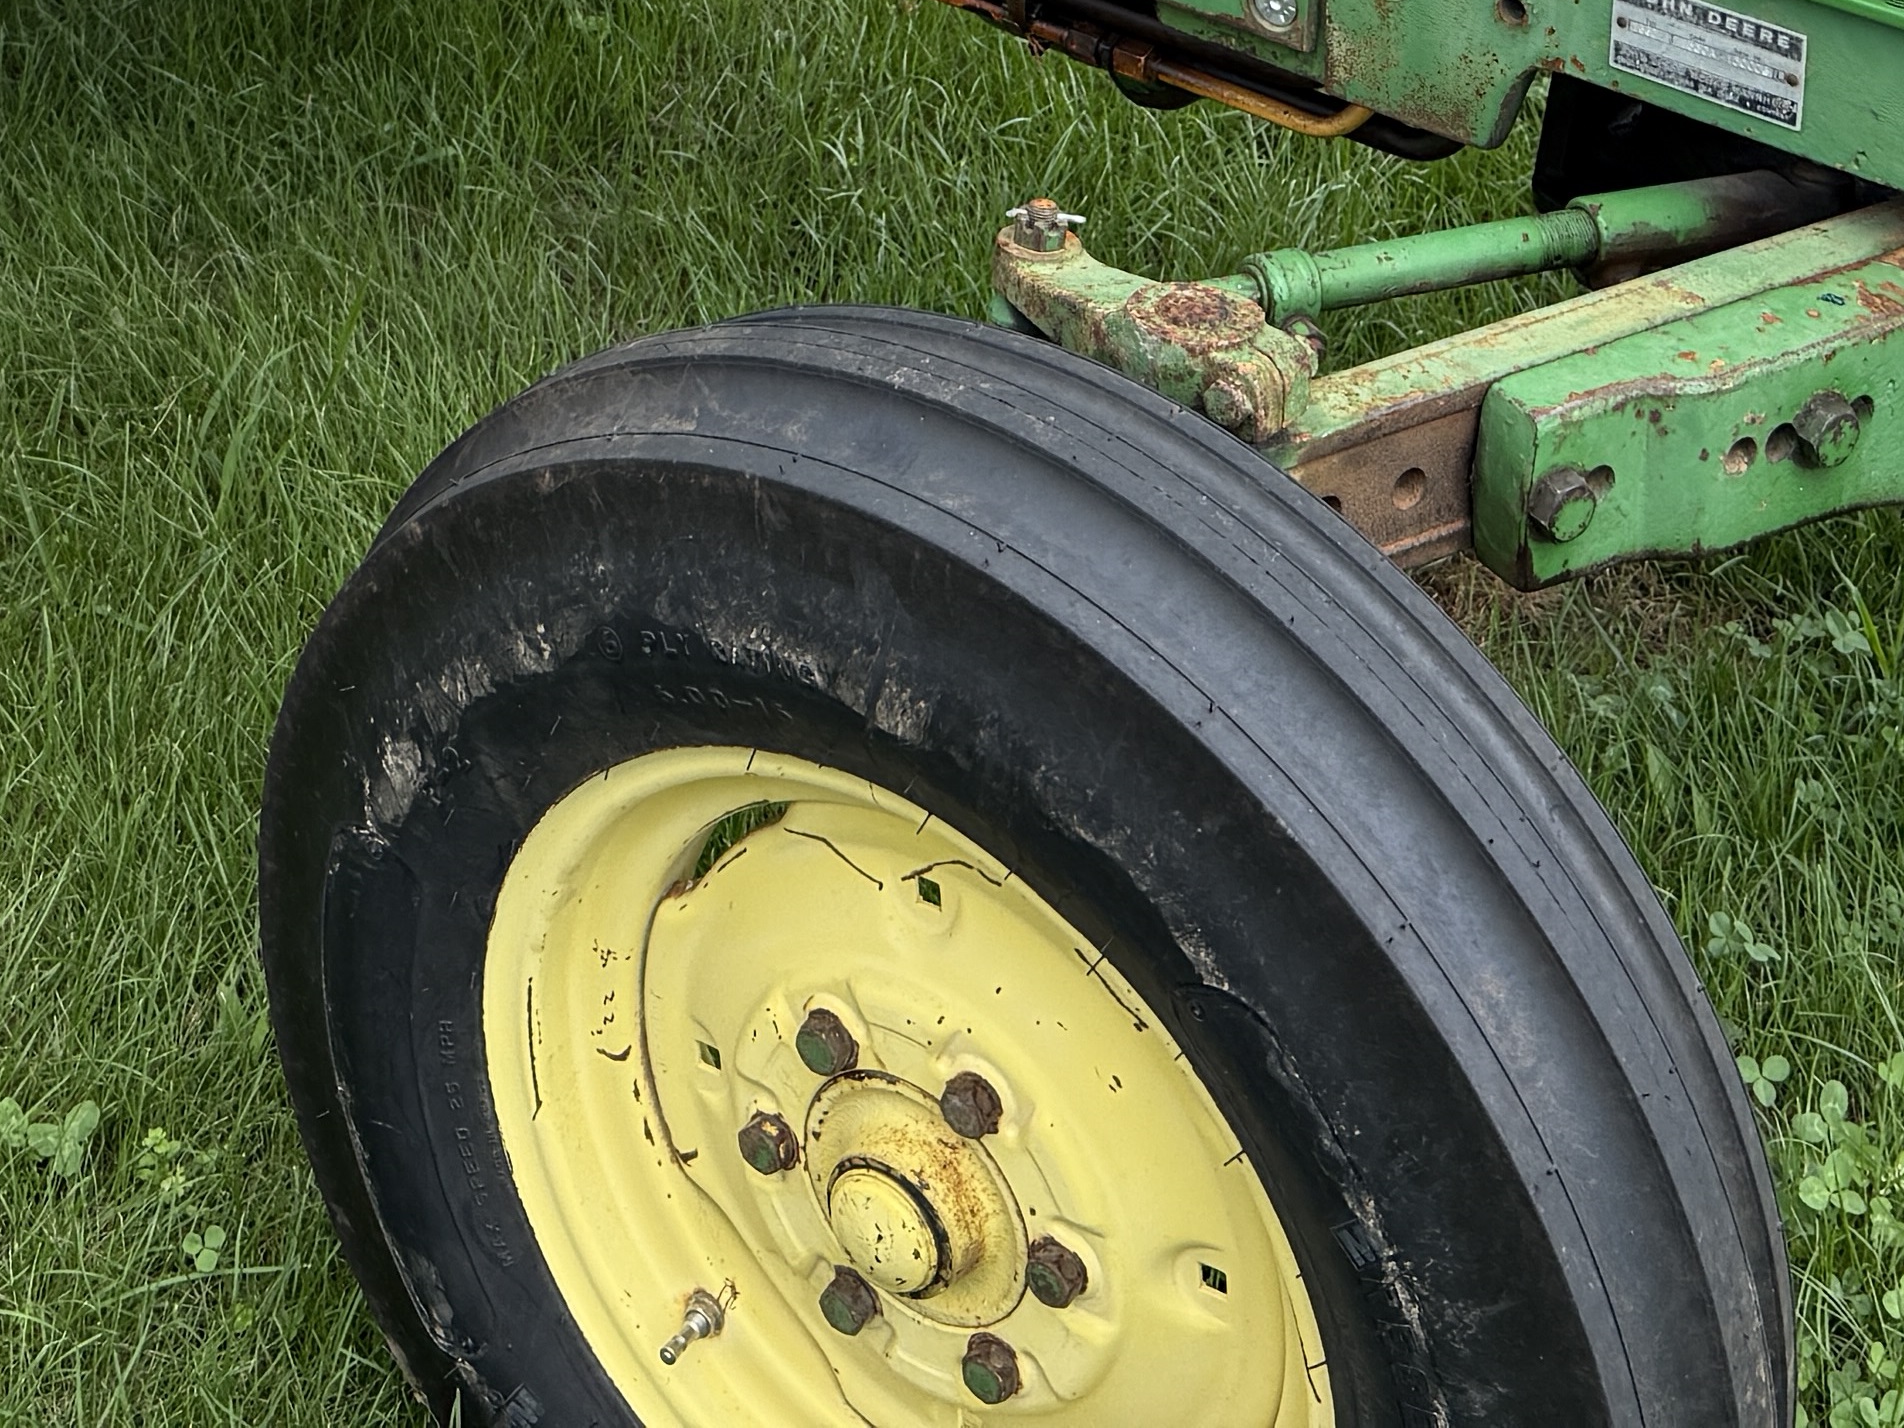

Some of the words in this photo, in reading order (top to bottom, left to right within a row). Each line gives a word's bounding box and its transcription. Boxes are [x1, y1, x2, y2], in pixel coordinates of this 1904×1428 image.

[1707, 10, 1791, 50] DEERE
[438, 1019, 456, 1065] MPH
[444, 1081, 465, 1111] 25
[455, 1127, 489, 1206] SPEED
